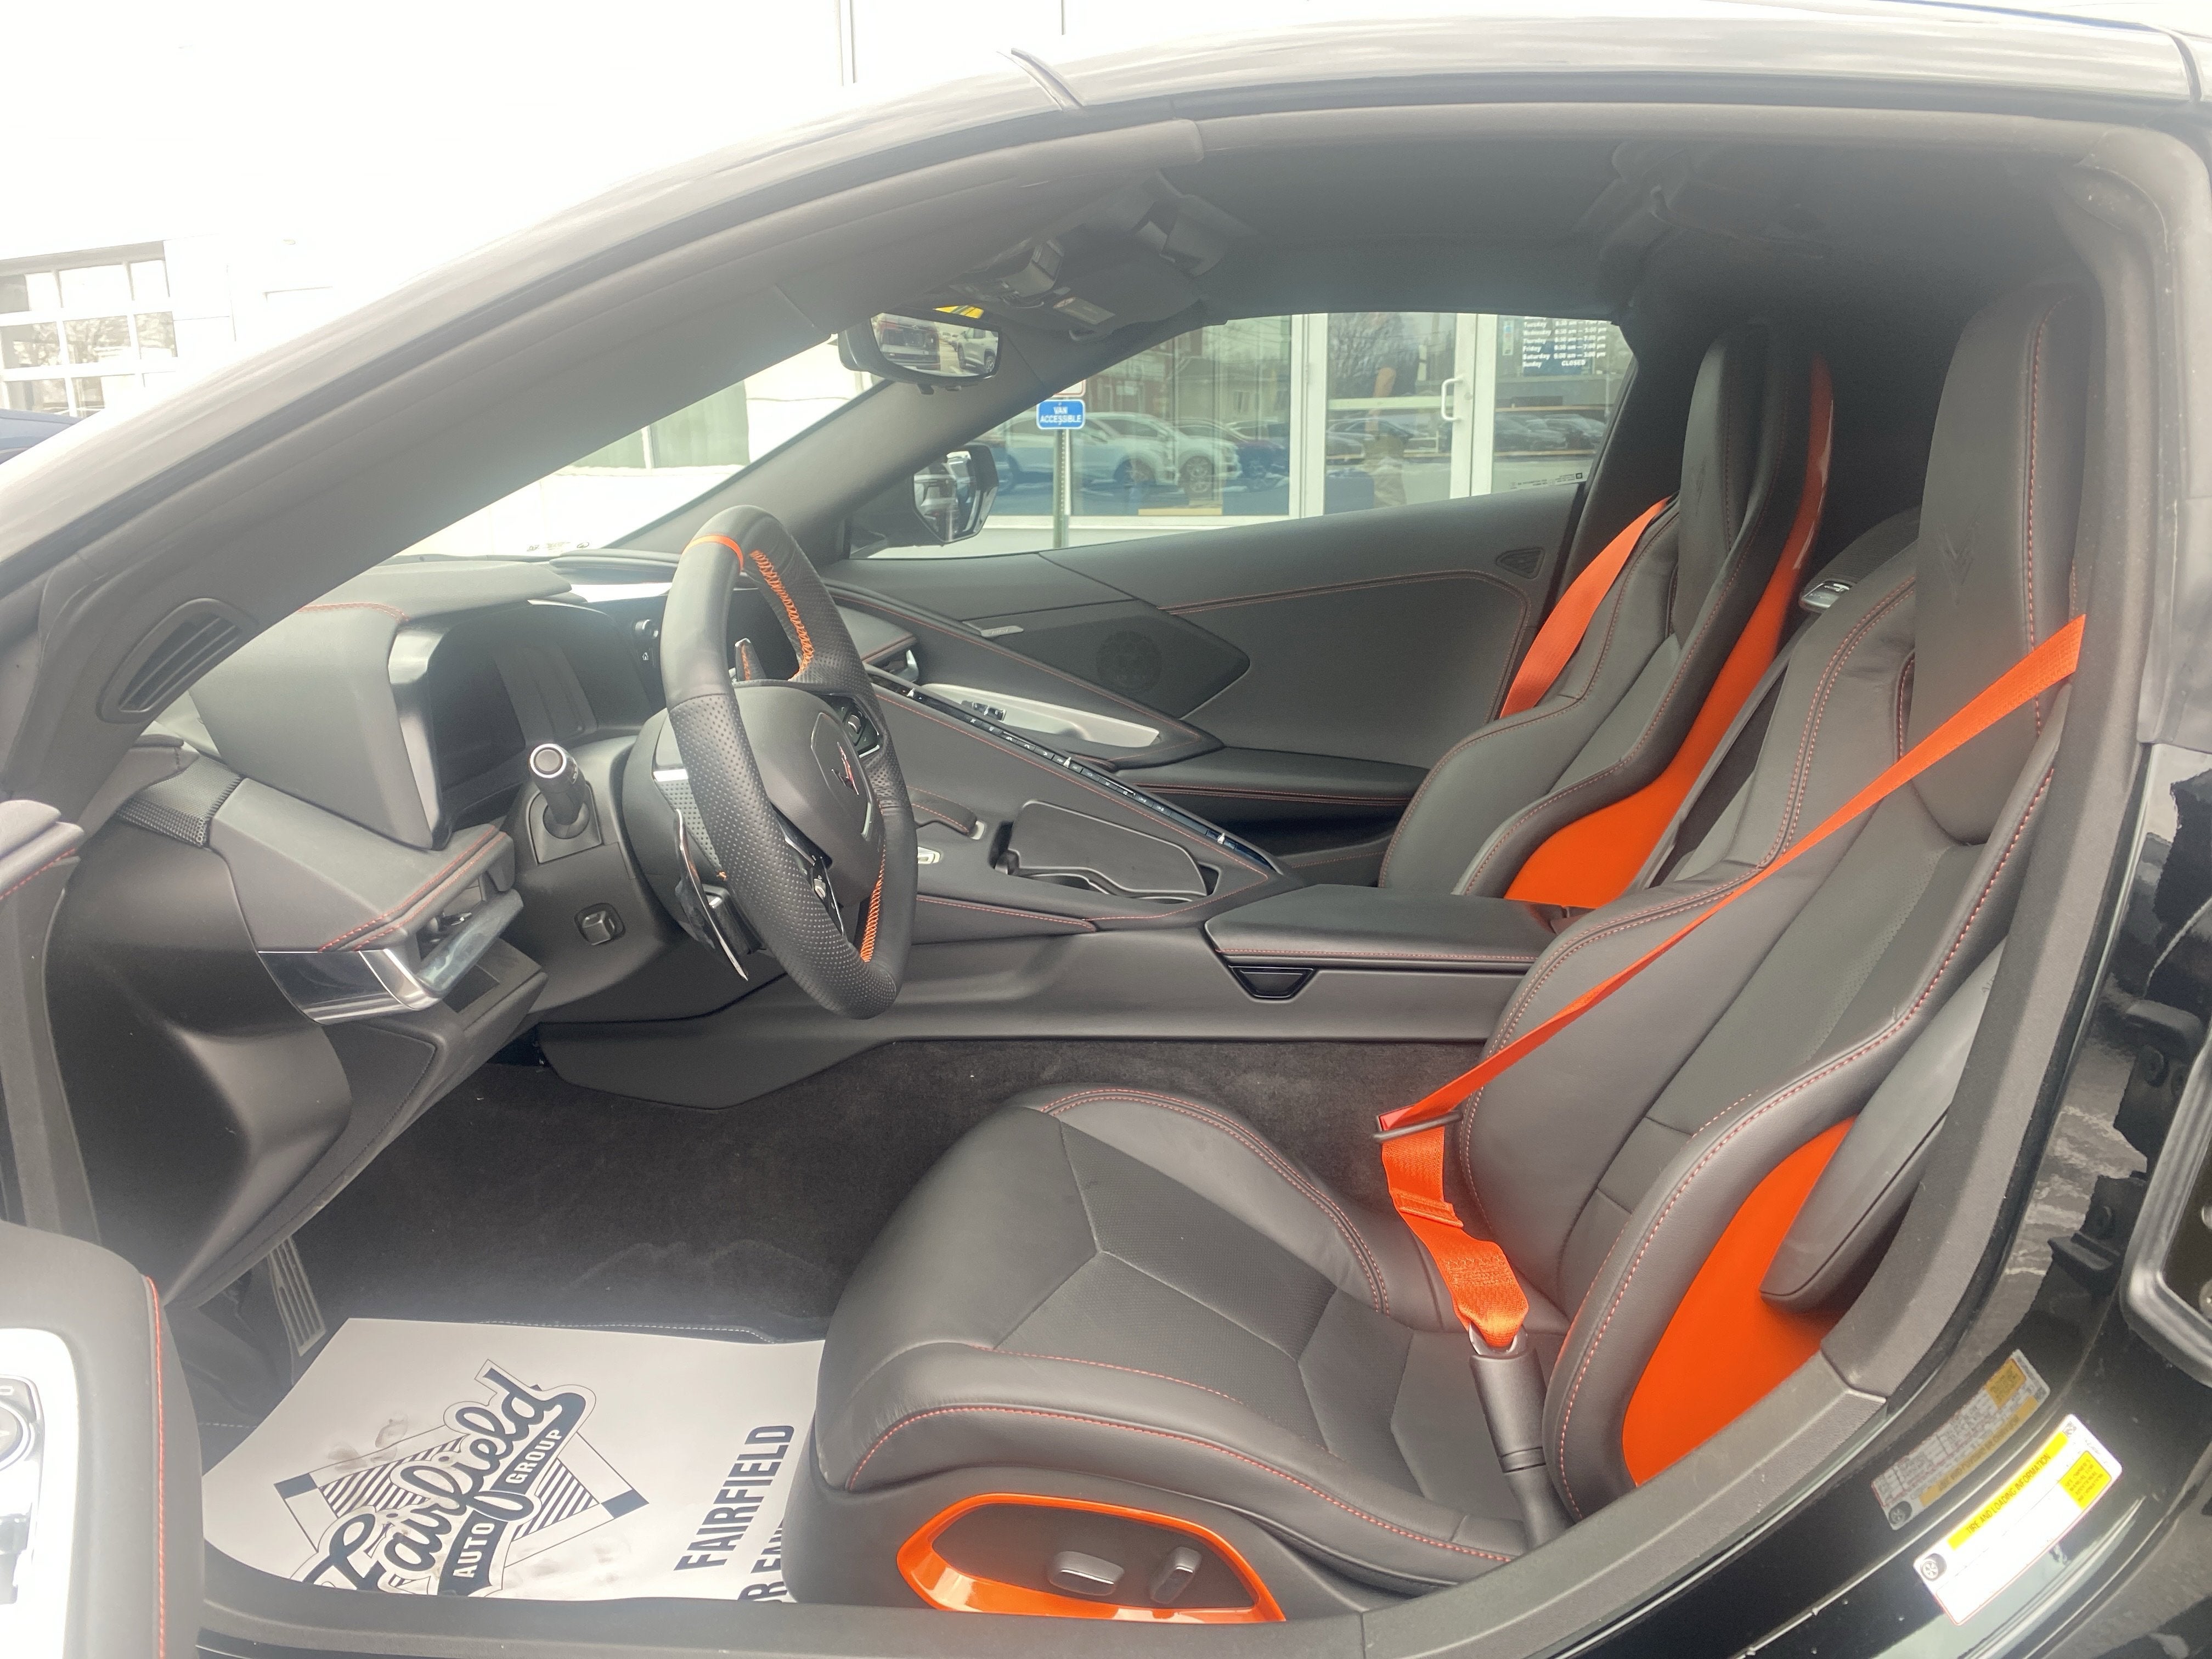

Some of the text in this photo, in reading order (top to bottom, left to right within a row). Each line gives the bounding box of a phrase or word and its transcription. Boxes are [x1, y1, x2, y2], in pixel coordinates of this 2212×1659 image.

[1040, 415, 1082, 423] ACCESSIBLE
[303, 1367, 587, 1591] Fairfield
[454, 1429, 562, 1578] AUTO GROUP
[674, 1425, 794, 1571] FAIRFIELD
[1966, 1453, 2051, 1534] TIRE AND LOADING INFORMATION
